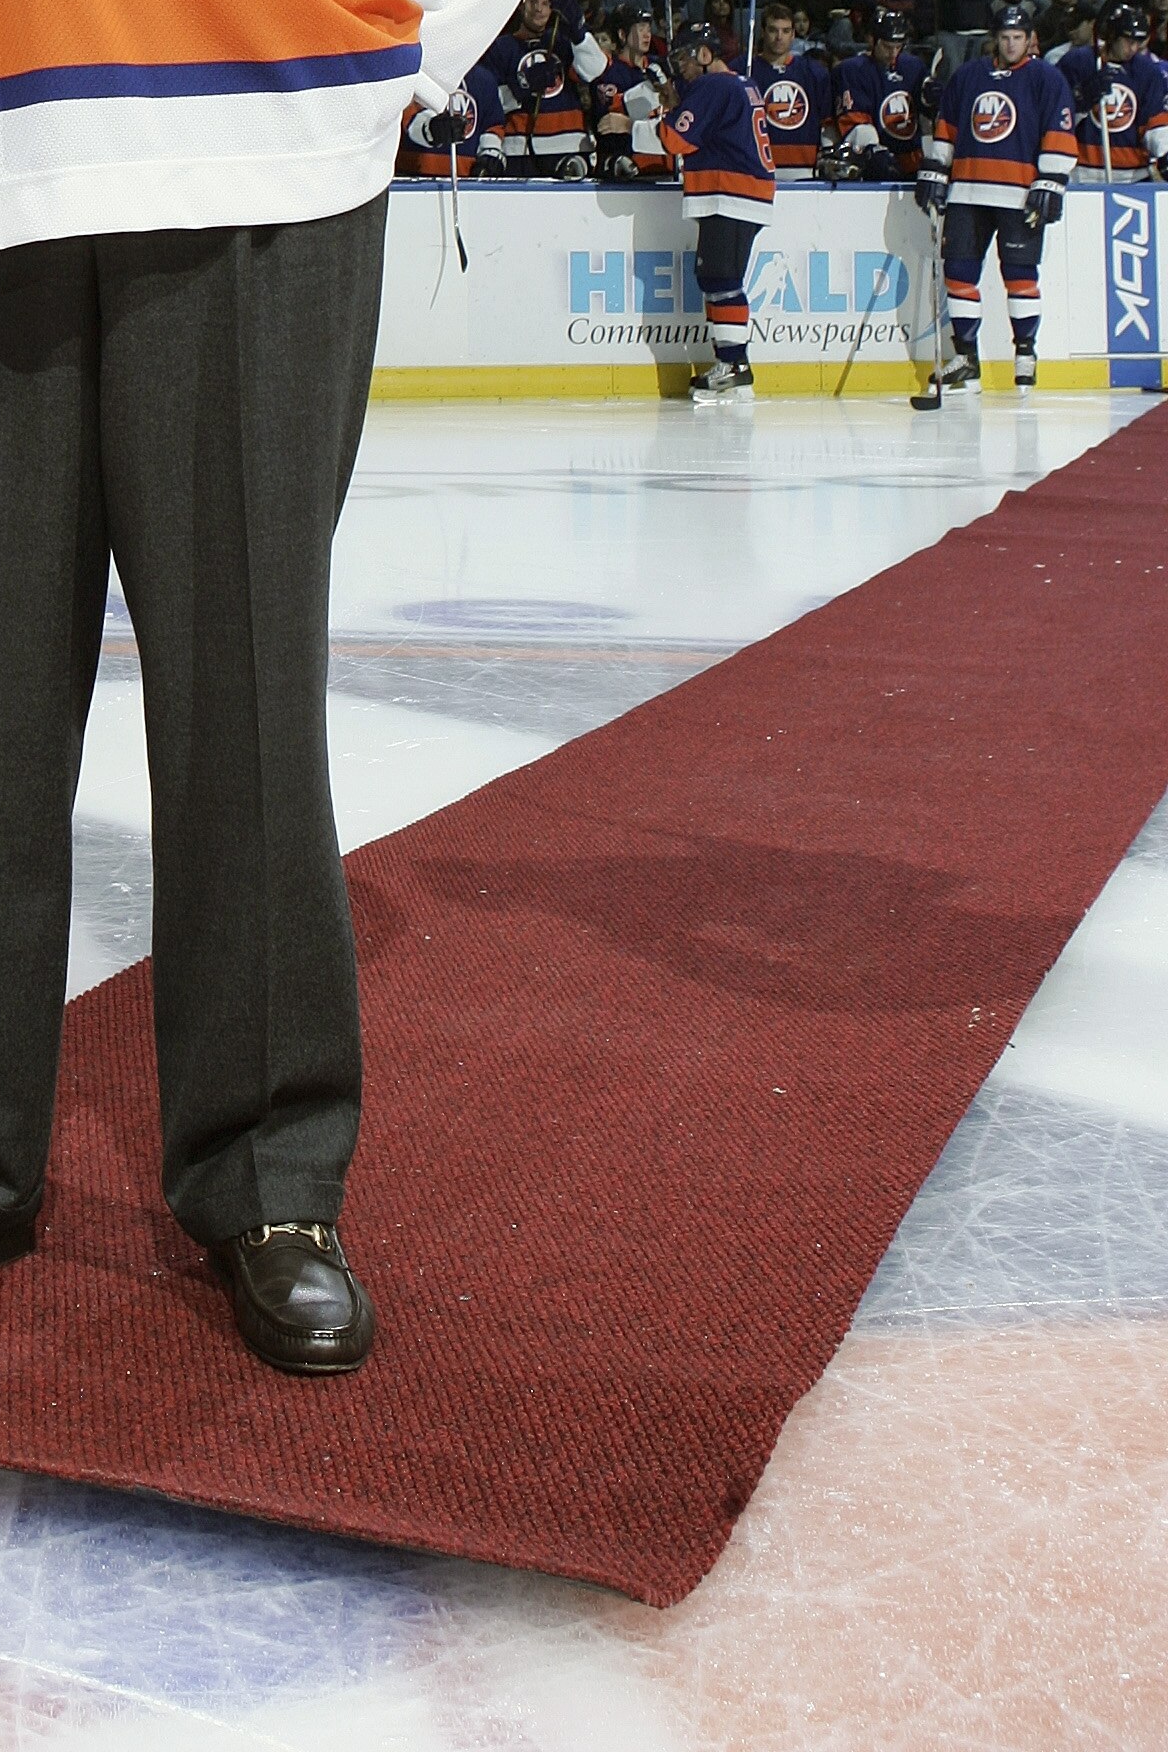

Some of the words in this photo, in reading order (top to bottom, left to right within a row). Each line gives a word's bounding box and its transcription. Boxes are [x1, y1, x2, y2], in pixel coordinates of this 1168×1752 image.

[675, 111, 694, 133] 6
[569, 251, 910, 314] HEALD
[568, 317, 716, 346] Communi
[748, 318, 911, 351] Newspapers
